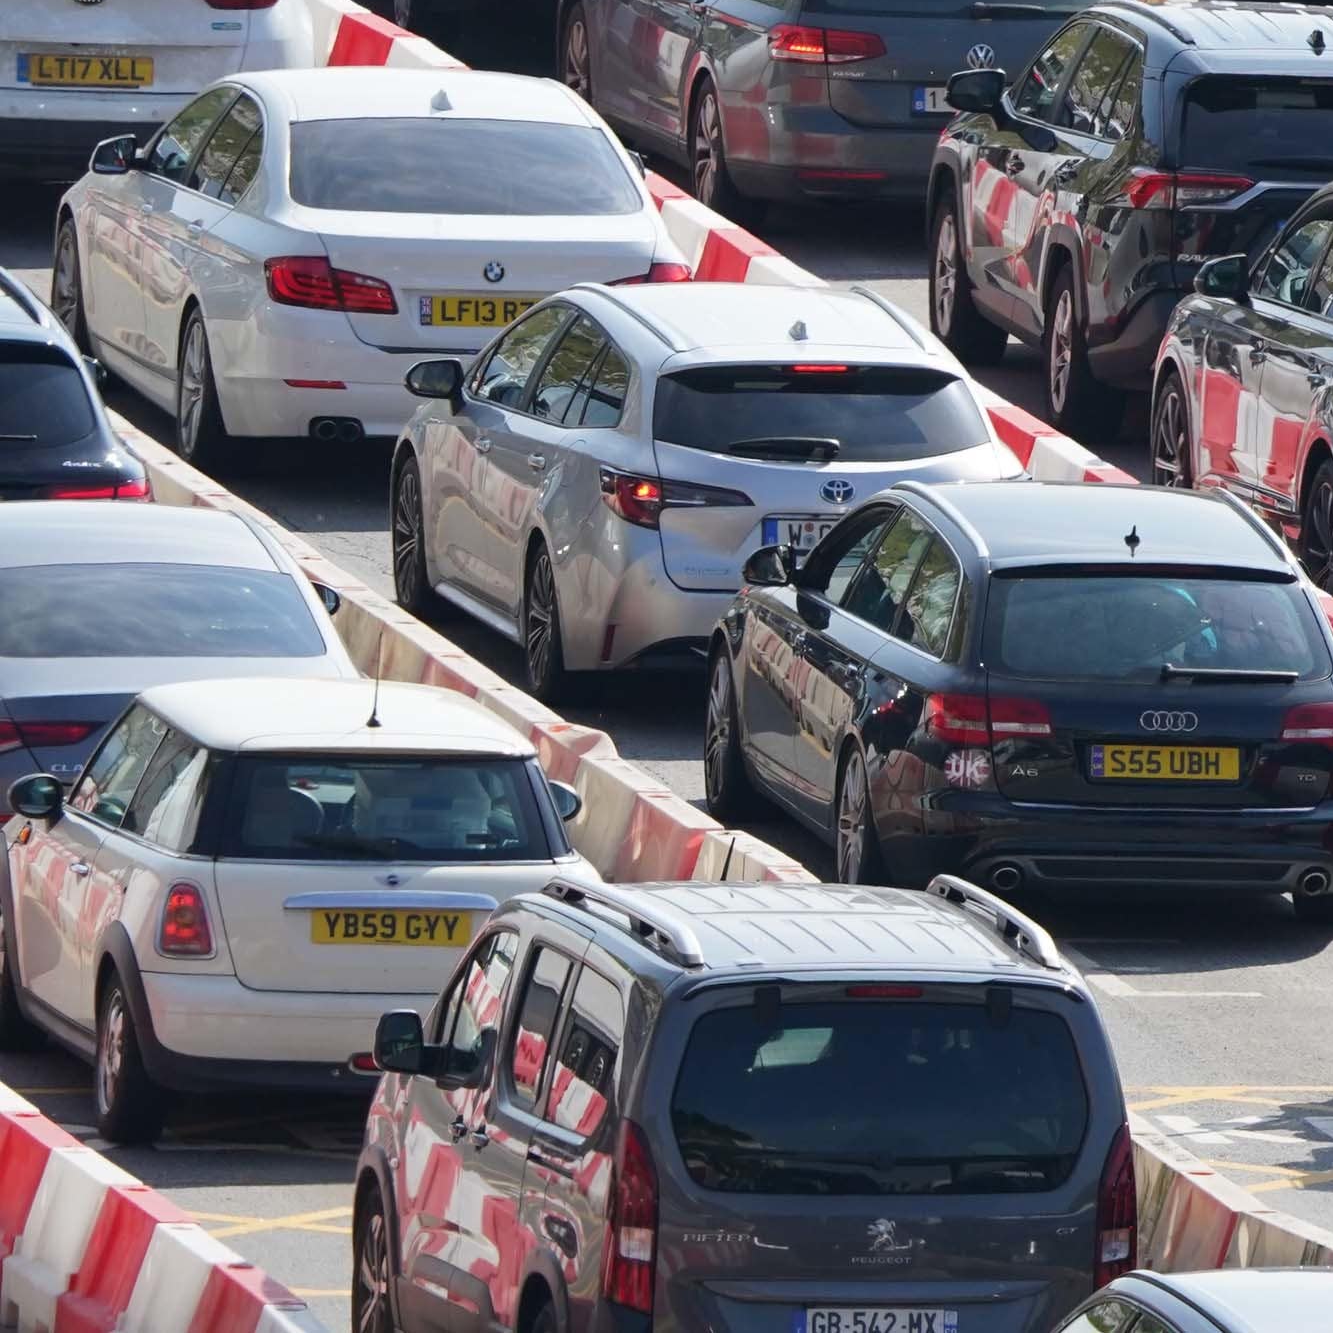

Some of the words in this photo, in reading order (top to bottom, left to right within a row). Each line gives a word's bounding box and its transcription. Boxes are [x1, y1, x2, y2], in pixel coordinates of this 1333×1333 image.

[37, 57, 93, 83] LT17
[99, 58, 147, 82] XLL
[1177, 253, 1209, 263] RAV
[440, 299, 497, 324] LF13
[503, 301, 540, 324] RZ
[1011, 764, 1039, 777] A6
[1110, 746, 1161, 773] S55
[1169, 747, 1220, 775] UBH
[324, 912, 397, 940] YB59
[405, 913, 460, 942] GYY
[811, 1311, 938, 1333] GB-542-MX
